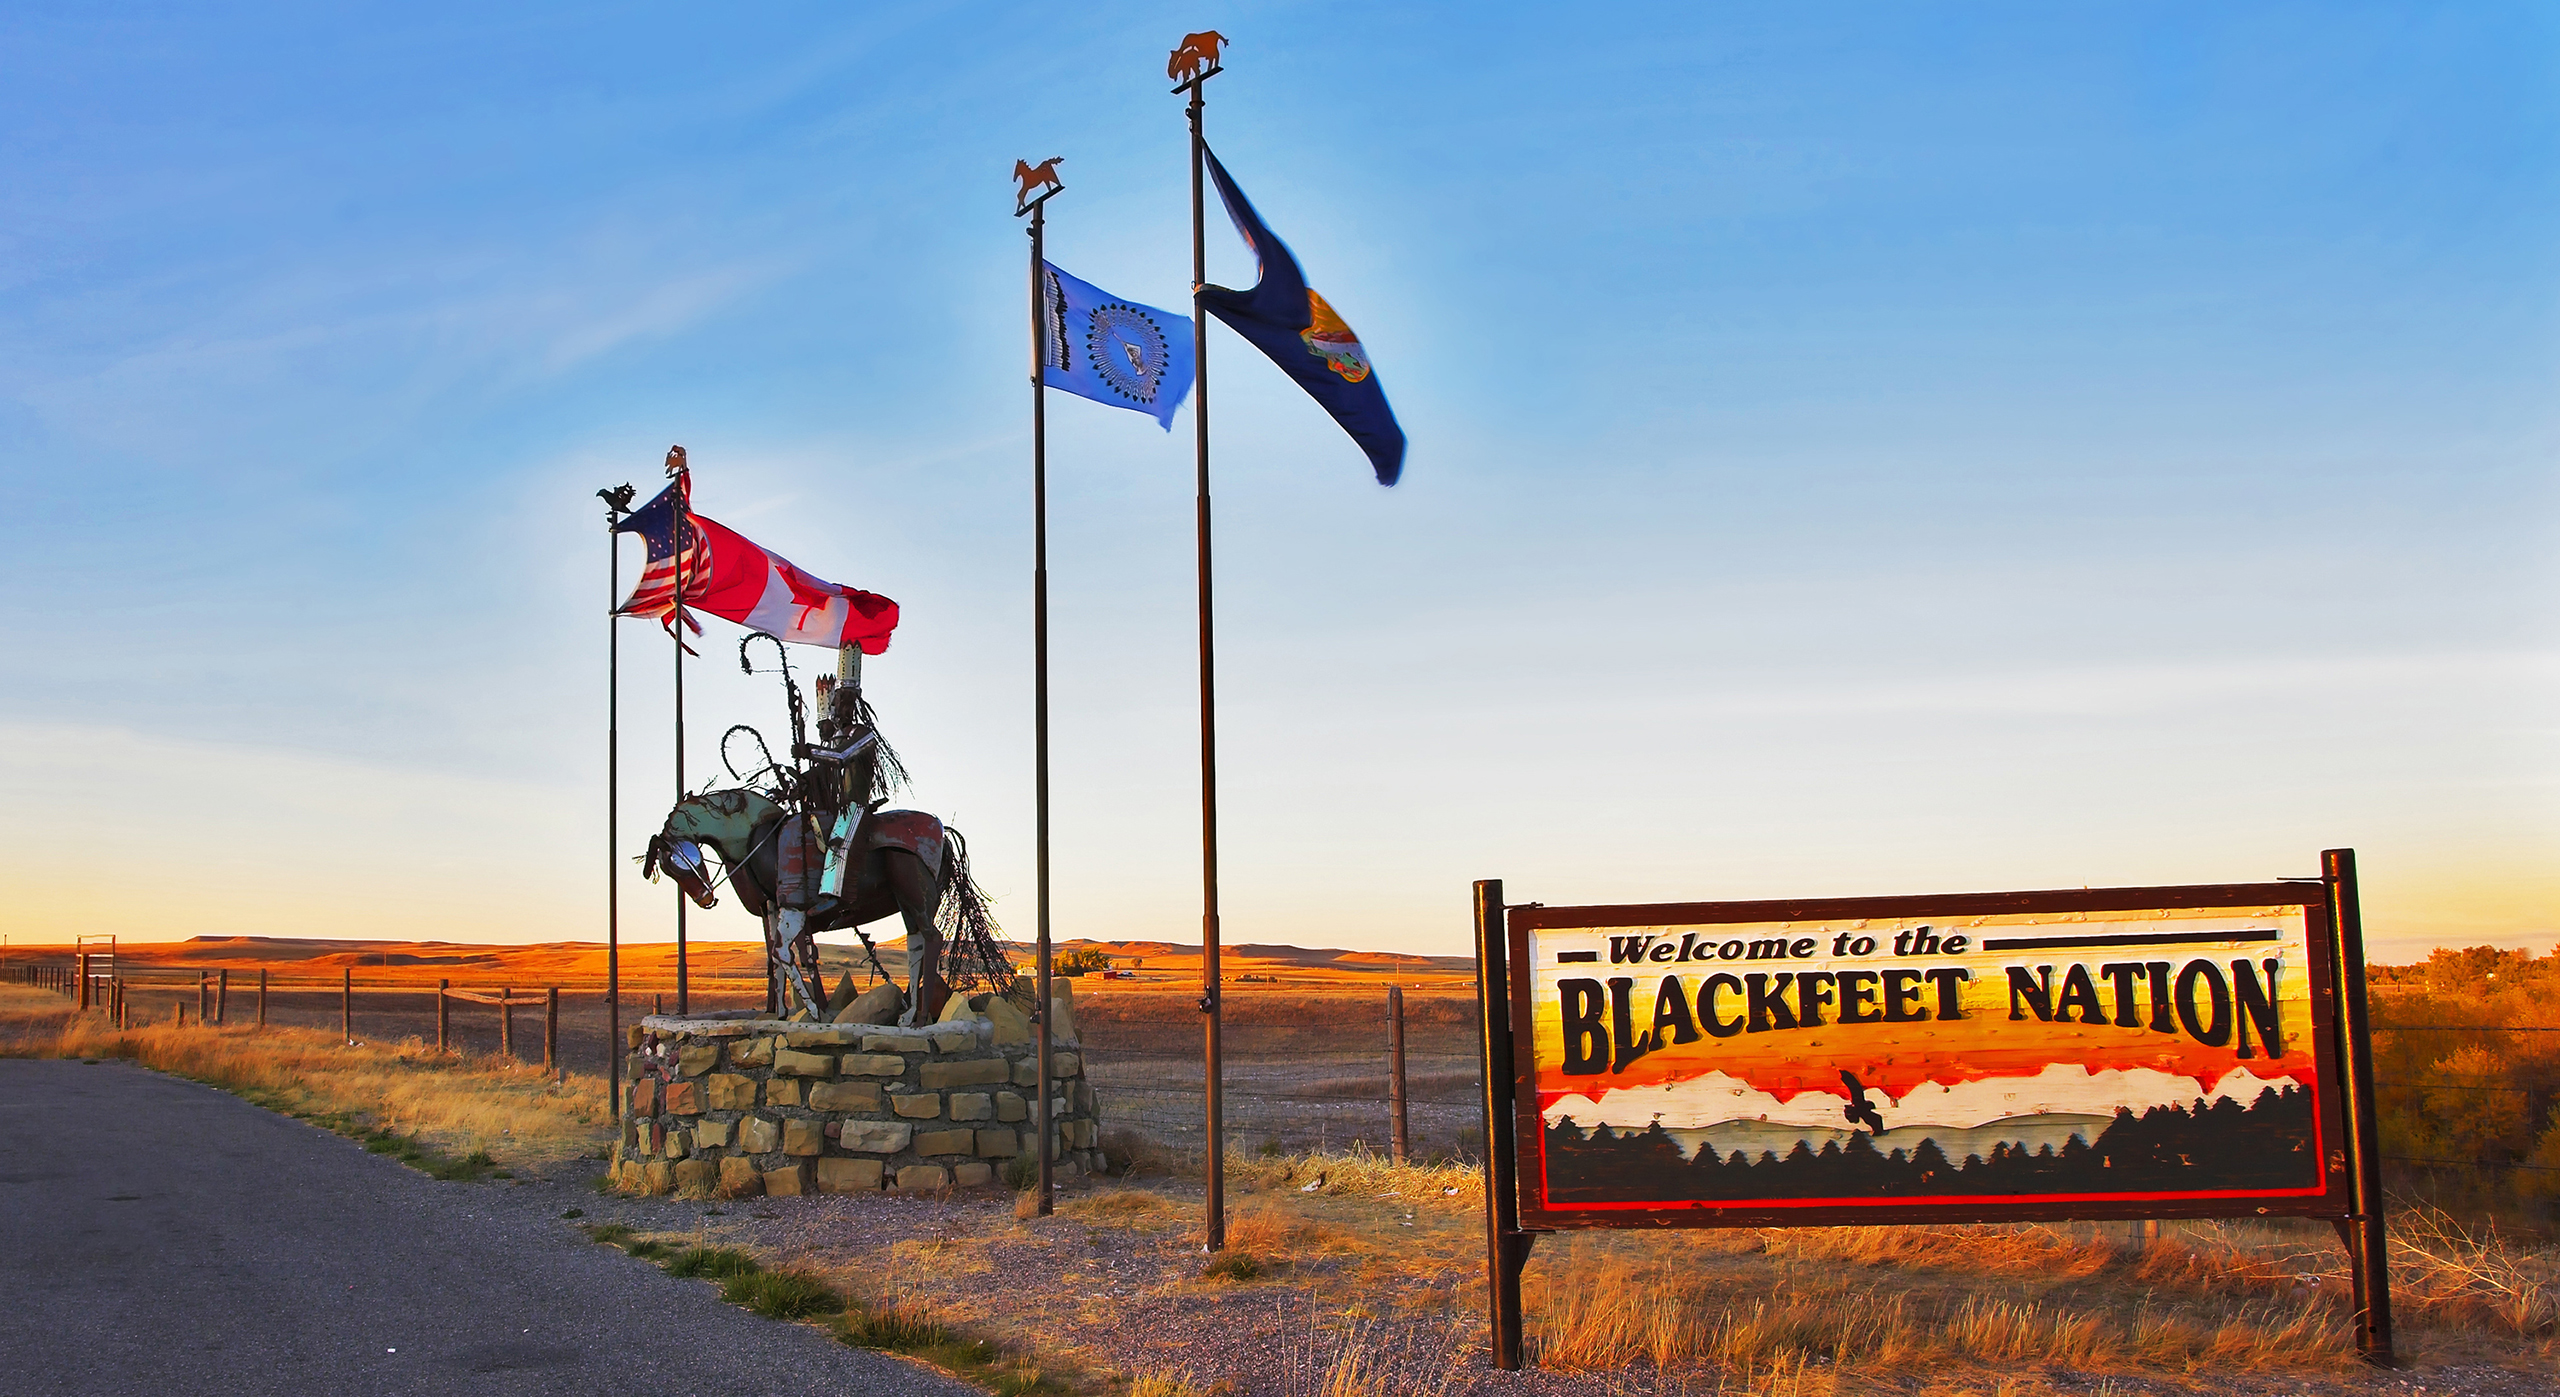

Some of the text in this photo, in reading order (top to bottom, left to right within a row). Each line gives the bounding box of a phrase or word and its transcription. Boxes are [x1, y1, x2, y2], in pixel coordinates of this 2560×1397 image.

[1609, 926, 1969, 964] Welcome to the
[1557, 958, 2281, 1075] BLACKFEET NATION
